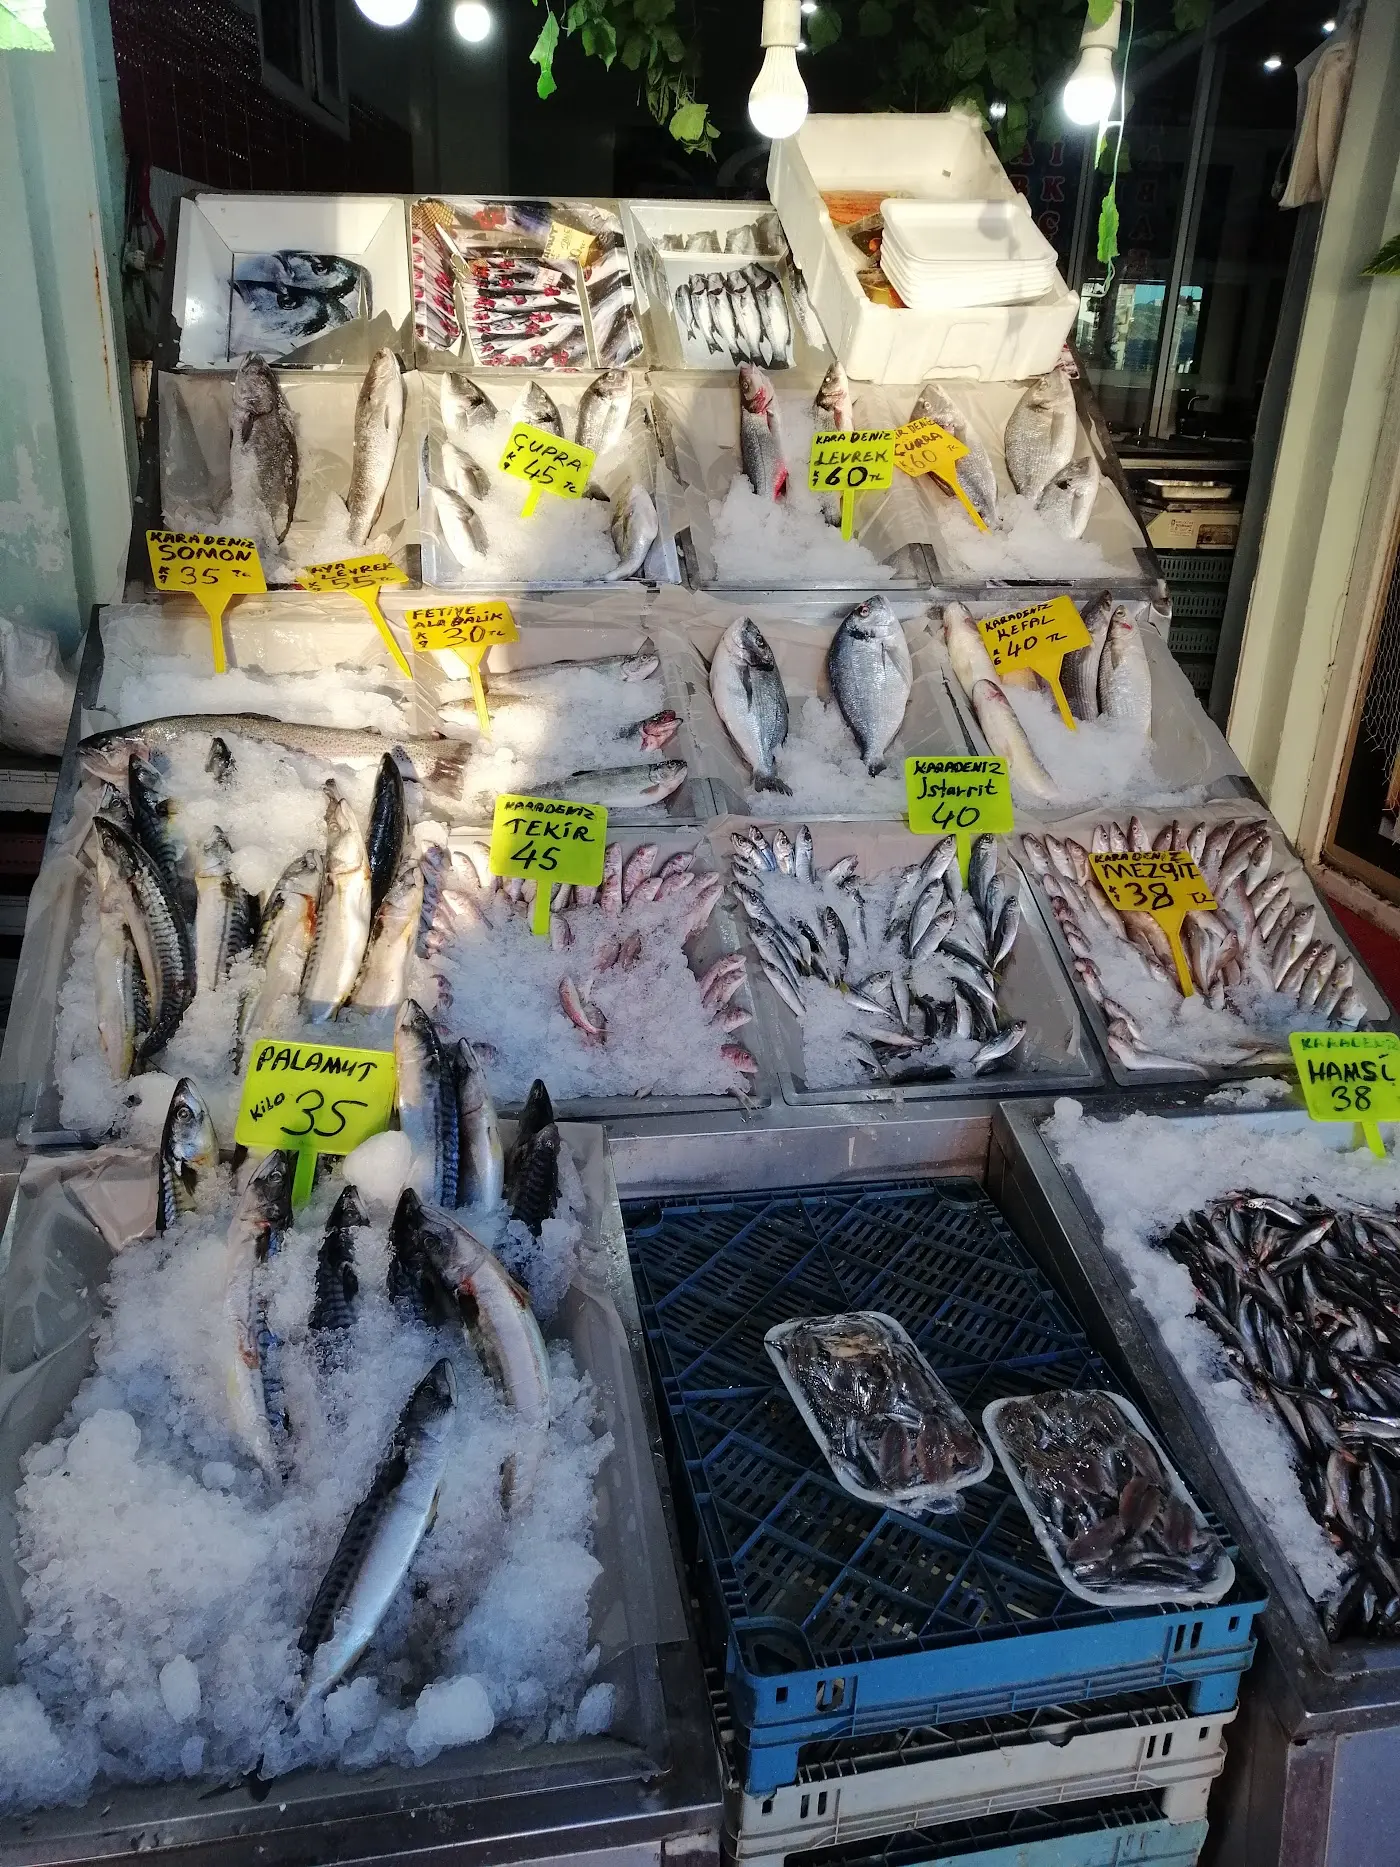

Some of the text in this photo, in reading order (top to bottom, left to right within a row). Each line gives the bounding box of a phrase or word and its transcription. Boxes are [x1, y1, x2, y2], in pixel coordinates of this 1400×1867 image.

[513, 433, 582, 472] ÇUPRA
[813, 449, 889, 466] LEVREK
[910, 449, 937, 469] 60
[523, 459, 557, 484] 45
[825, 466, 869, 487] 60
[869, 473, 885, 482] TL
[158, 544, 252, 561] SOMON
[180, 566, 220, 585] 35
[331, 574, 377, 590] 55
[443, 625, 486, 647] 30
[997, 615, 1056, 642] KEFAL
[1007, 635, 1038, 658] 40
[1045, 632, 1068, 642] TL
[931, 801, 981, 830] 40
[502, 818, 596, 842] TEKİR
[510, 840, 561, 871] 45
[1124, 882, 1175, 911] 38
[256, 1045, 378, 1082] PALAMUT
[1307, 1053, 1397, 1085] HAMSİ
[1331, 1085, 1372, 1112] 38
[279, 1089, 369, 1138] 35
